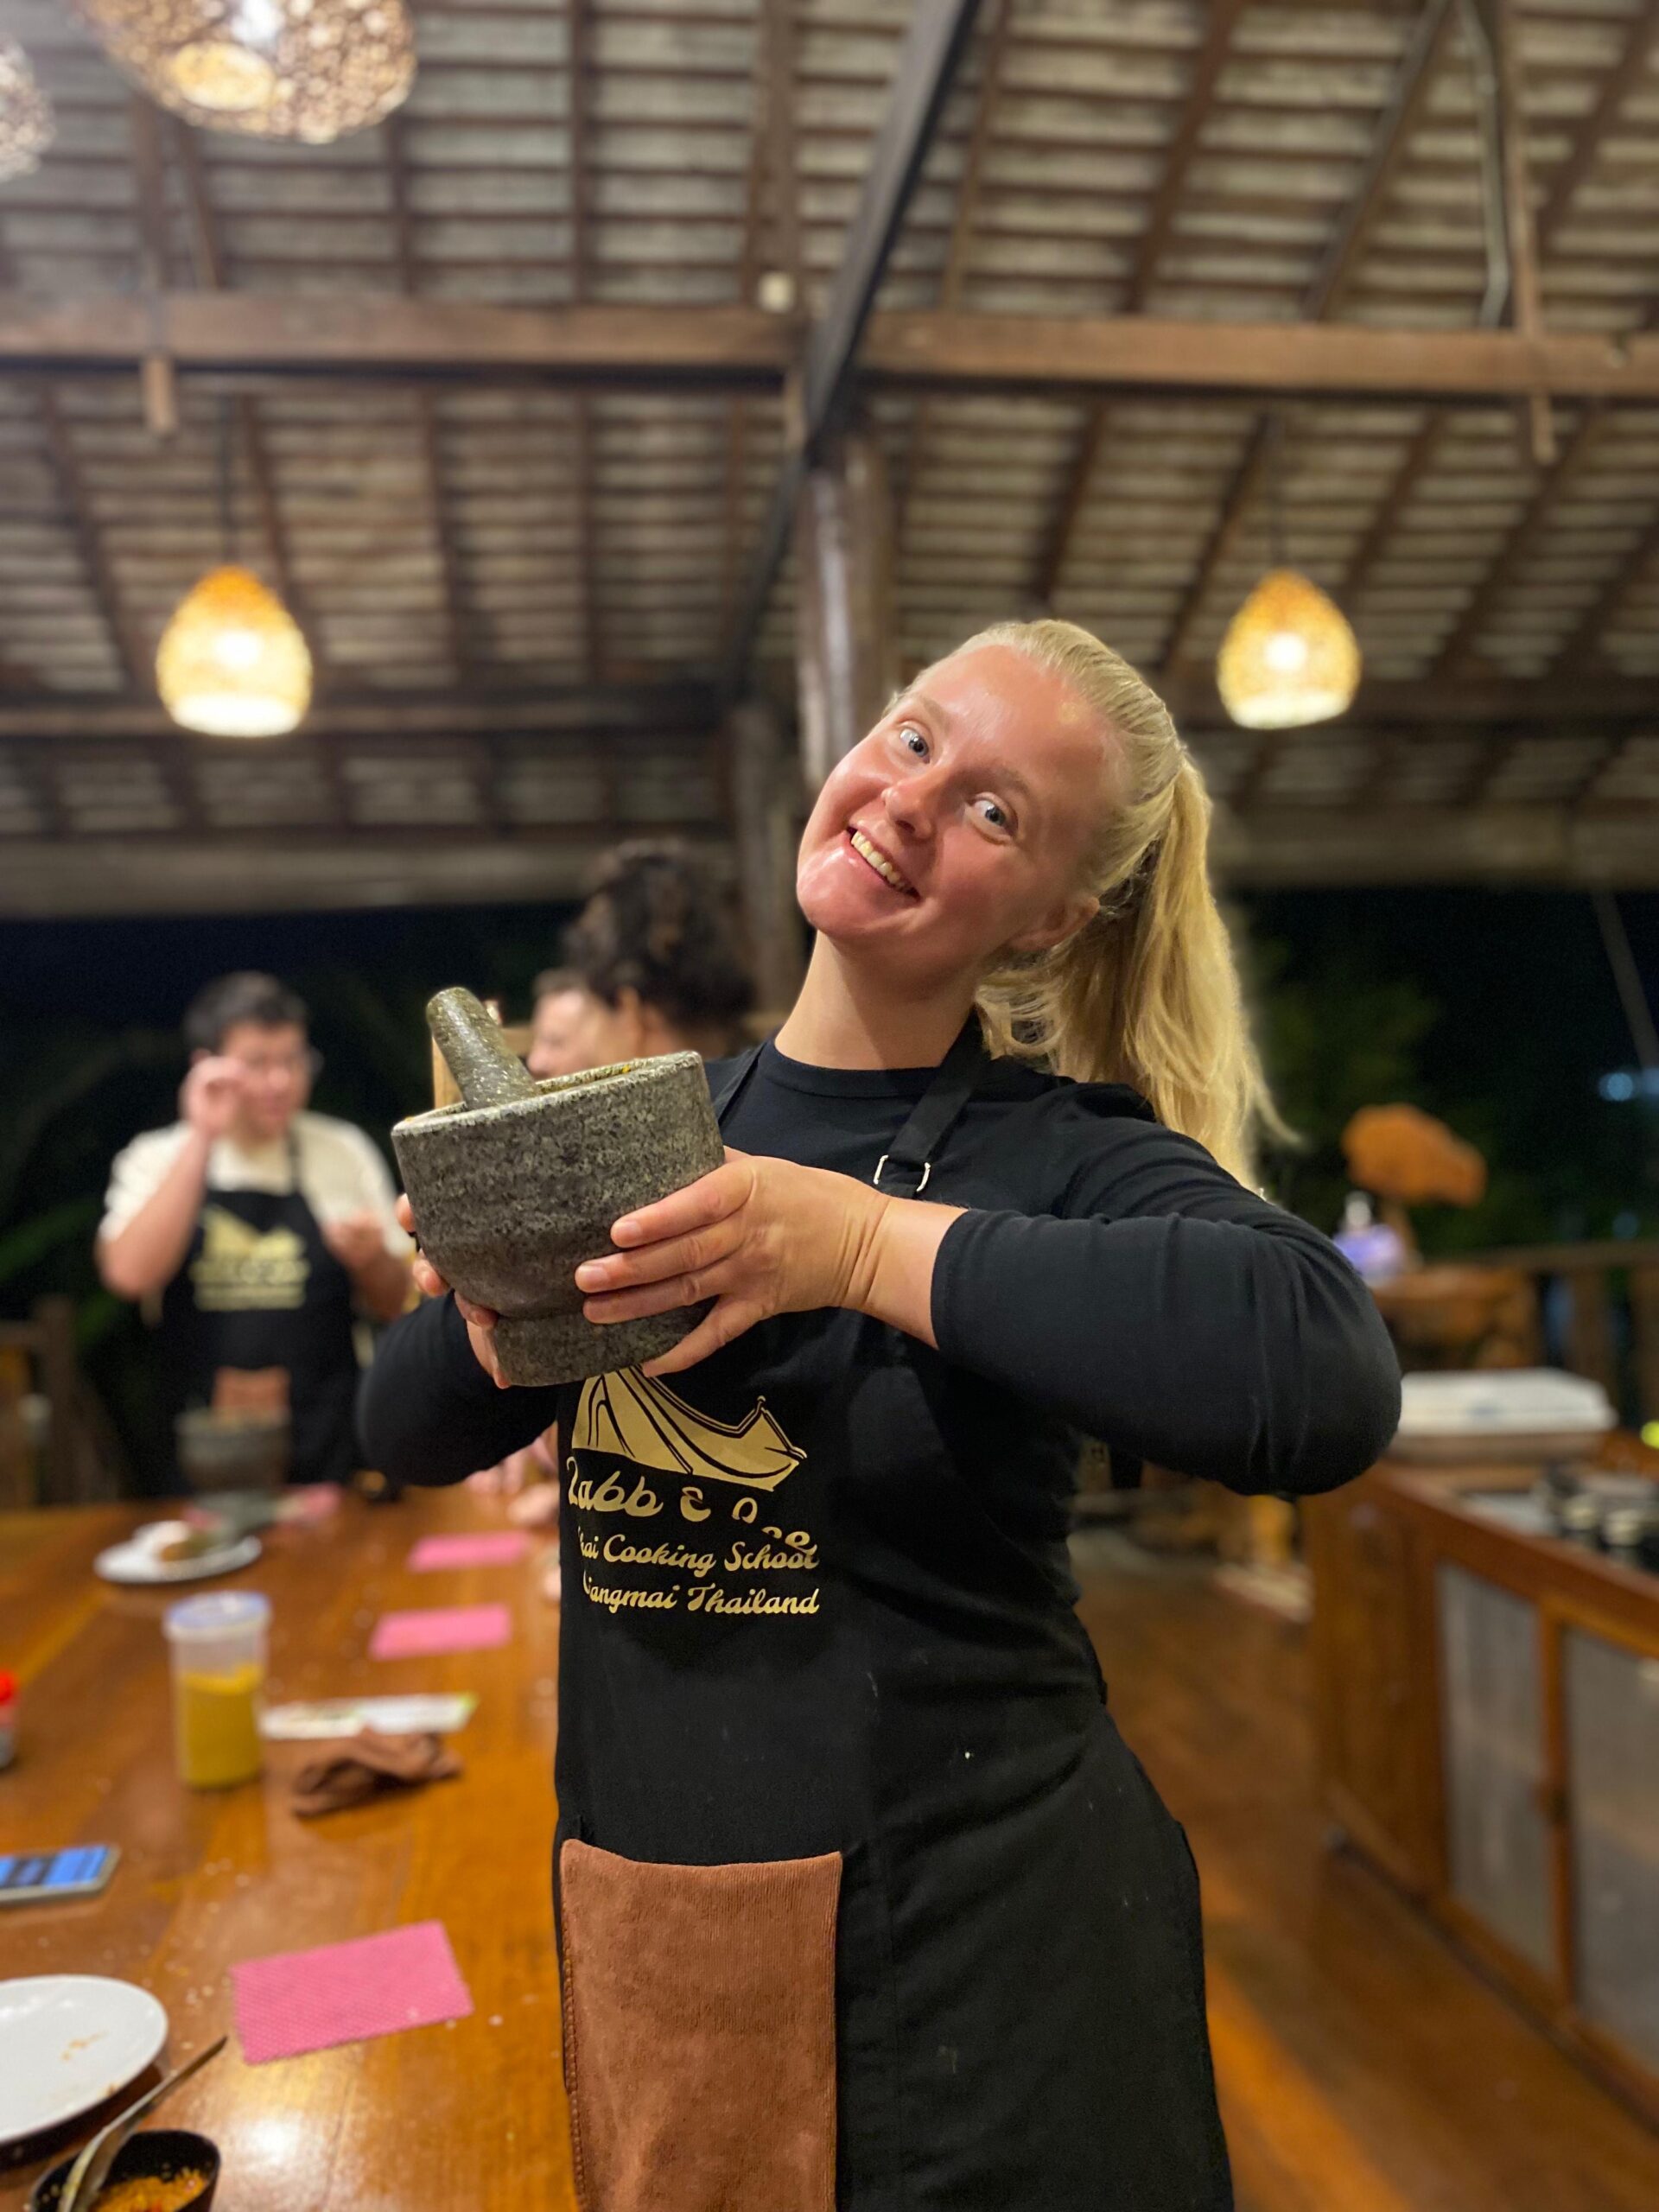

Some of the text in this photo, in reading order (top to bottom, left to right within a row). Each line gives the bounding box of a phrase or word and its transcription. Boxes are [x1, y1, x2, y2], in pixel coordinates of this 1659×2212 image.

[603, 1534, 717, 1578] Cooking
[724, 1541, 820, 1572] School
[687, 1582, 820, 1615] Thailand
